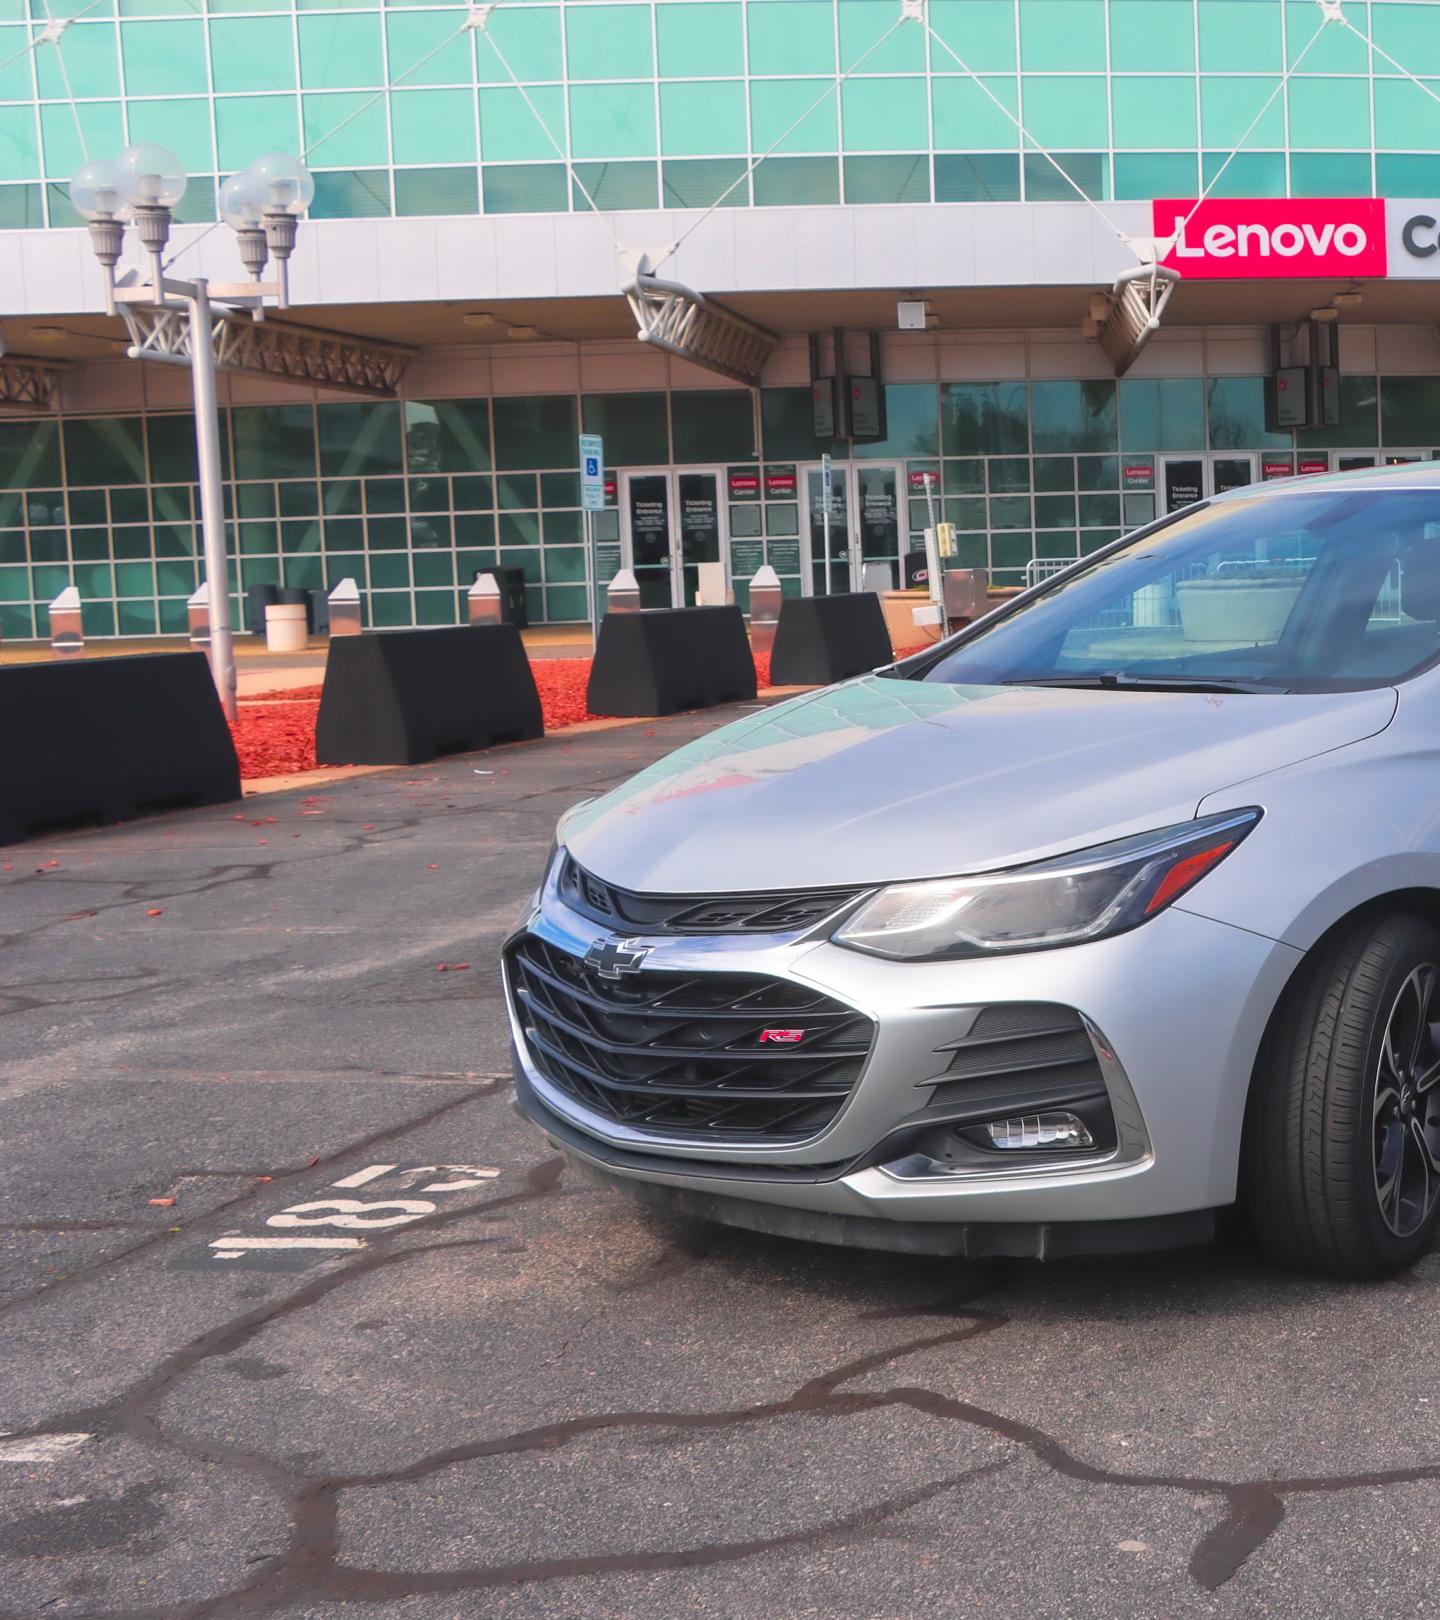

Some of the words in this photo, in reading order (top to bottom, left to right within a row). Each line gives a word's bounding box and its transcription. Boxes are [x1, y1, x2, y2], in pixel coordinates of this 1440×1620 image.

[1174, 215, 1368, 258] Lenovo
[768, 478, 793, 487] Lenovo
[759, 1029, 805, 1043] RS
